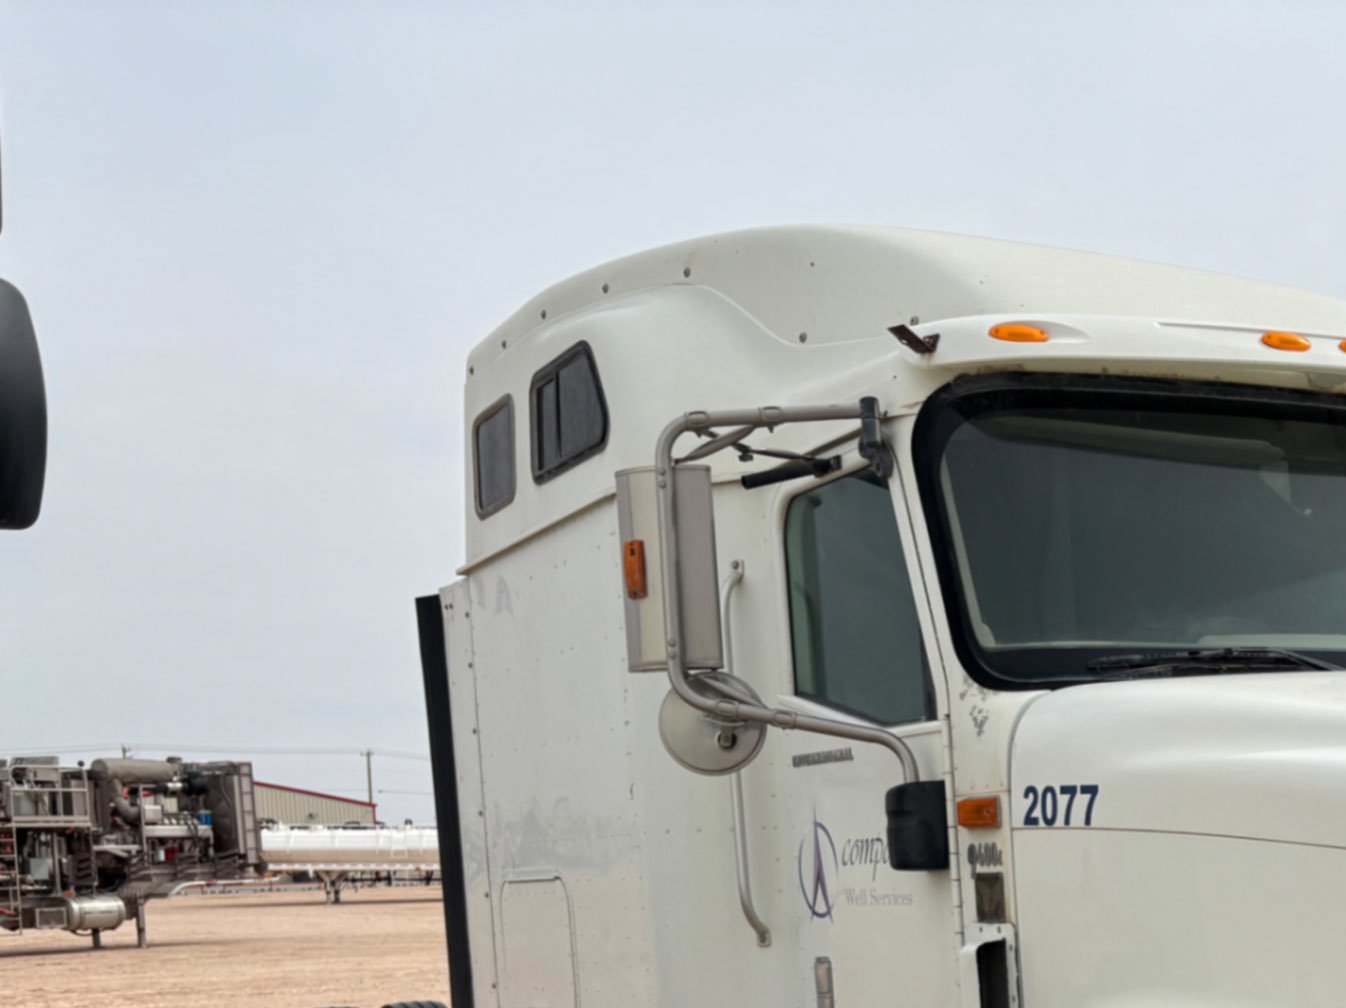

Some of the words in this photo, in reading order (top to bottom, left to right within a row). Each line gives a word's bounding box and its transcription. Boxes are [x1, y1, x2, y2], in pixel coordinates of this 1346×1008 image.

[1023, 785, 1099, 826] 2077
[844, 888, 867, 906] Well
[870, 888, 913, 906] Services
